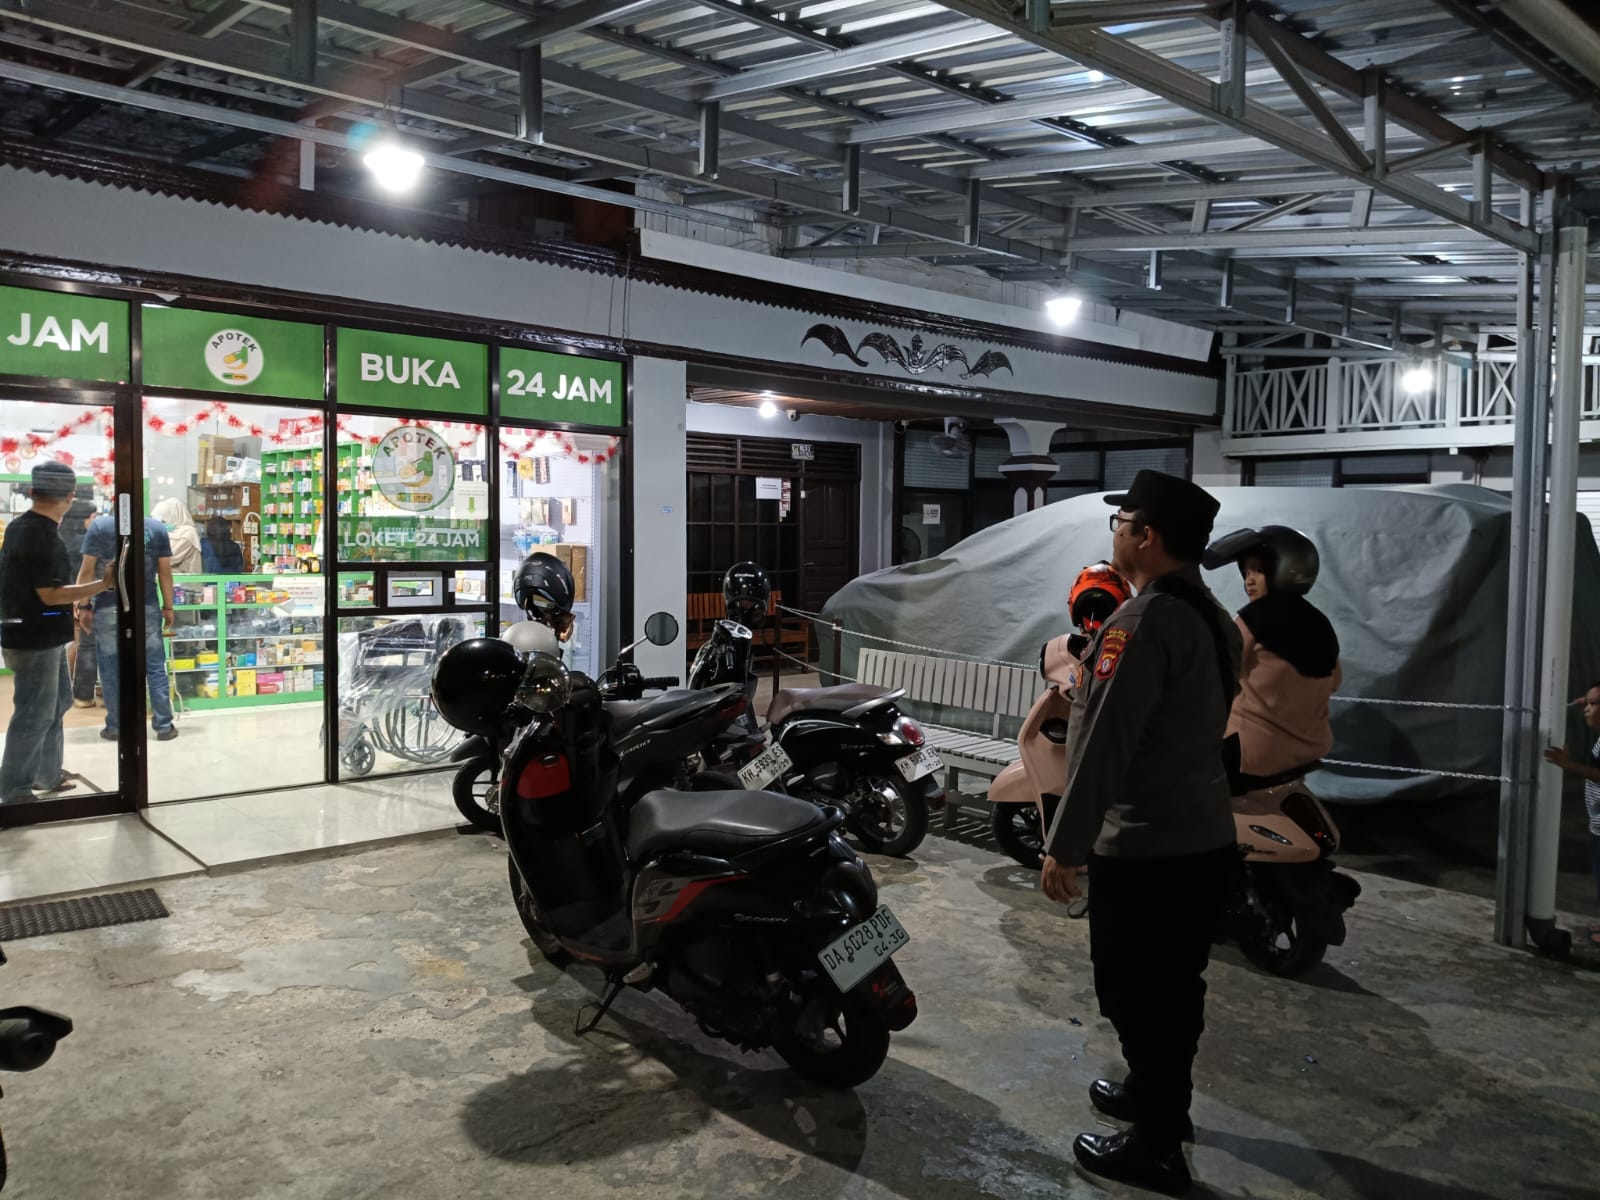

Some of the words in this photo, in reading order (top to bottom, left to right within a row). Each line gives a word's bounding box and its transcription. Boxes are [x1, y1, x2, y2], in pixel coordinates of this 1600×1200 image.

[7, 313, 109, 354] JAM
[211, 332, 257, 352] APOTEK
[360, 352, 461, 389] BUKA
[506, 369, 546, 397] 24
[552, 374, 612, 404] JAM
[383, 432, 446, 460] APOTEK
[344, 531, 408, 547] LOKET
[415, 532, 438, 547] 24
[443, 532, 479, 547] JAM
[741, 768, 755, 784] KH
[823, 948, 846, 971] DA
[871, 909, 893, 936] PDF
